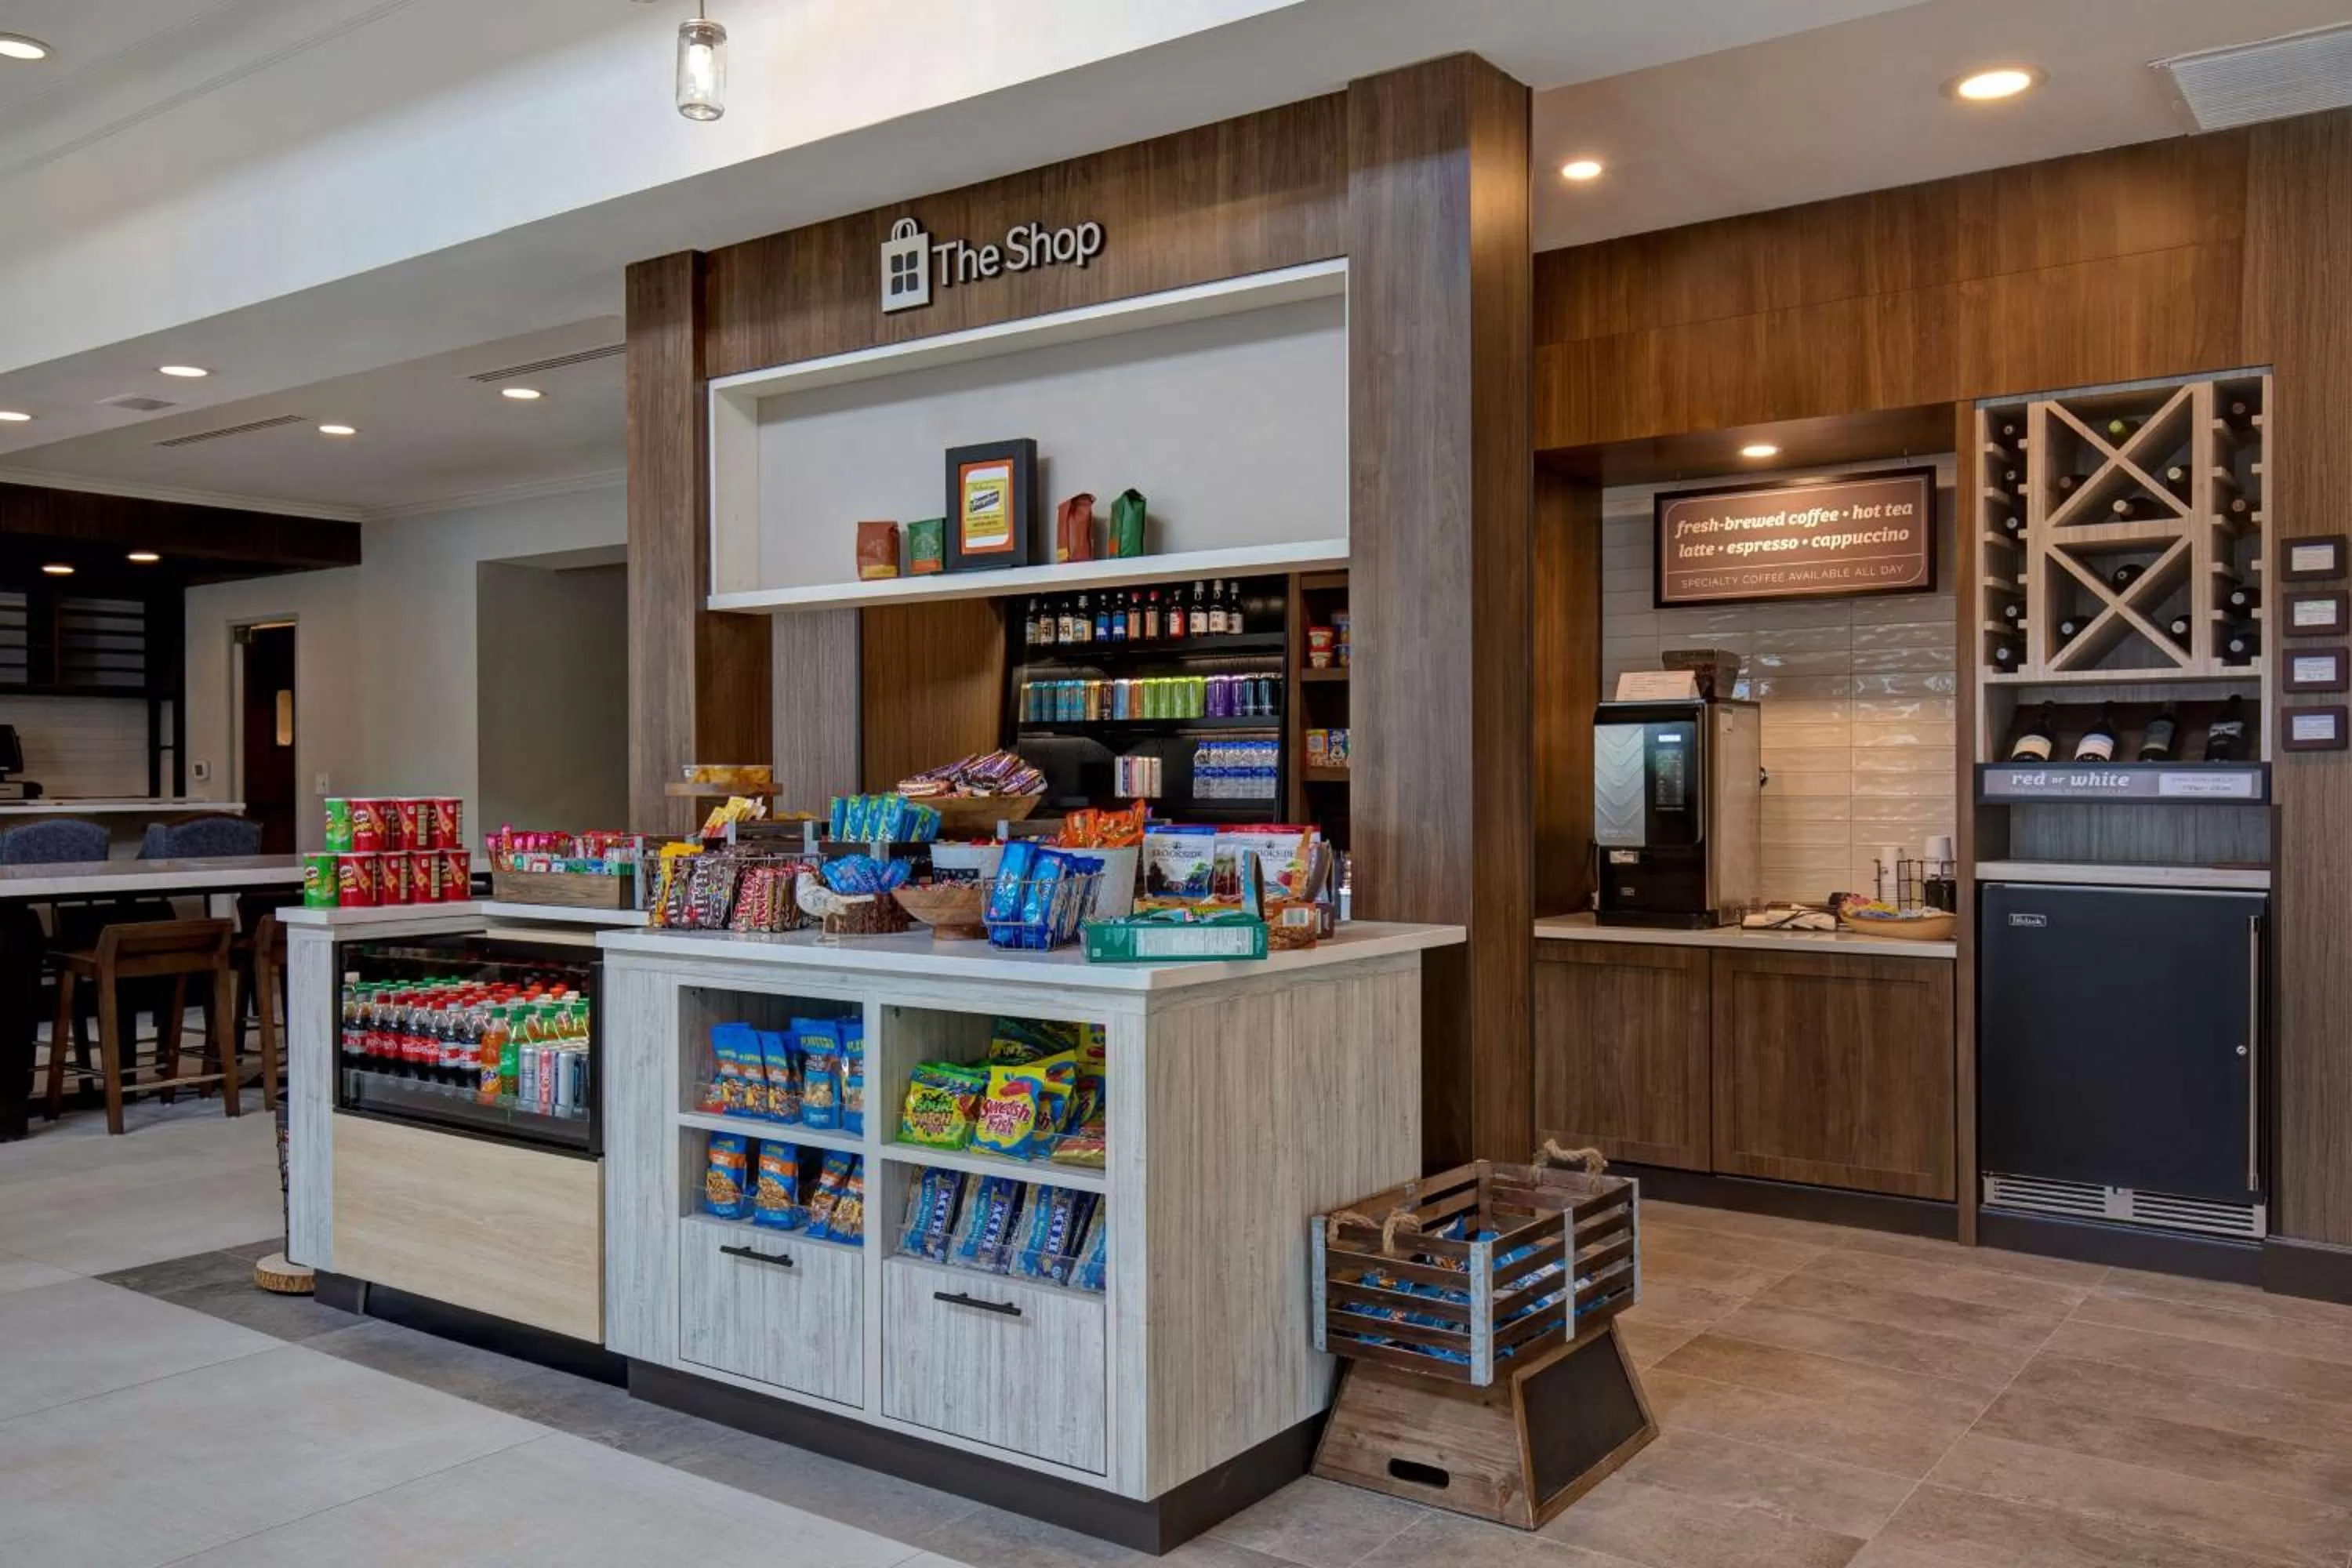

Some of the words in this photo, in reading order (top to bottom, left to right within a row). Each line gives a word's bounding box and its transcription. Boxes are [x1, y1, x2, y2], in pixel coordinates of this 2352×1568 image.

[931, 238, 1000, 286] The
[1004, 222, 1102, 270] Shop
[1675, 511, 1785, 538] fresh-brewed
[1788, 508, 1839, 528] coffee
[1853, 504, 1882, 519] hot
[1884, 503, 1913, 517] tea
[1679, 543, 1715, 558] latte
[1726, 536, 1798, 557] espresso
[1812, 527, 1910, 550] cappuccino
[1681, 576, 1737, 589] SPECIALTY
[1743, 572, 1784, 584] COFFEE
[1789, 568, 1850, 582] AVAILABLE
[1855, 565, 1876, 577] ALL
[1881, 564, 1905, 575] DAY
[2011, 772, 2046, 786] red
[2070, 771, 2130, 787] white
[980, 1098, 1031, 1123] Swedish
